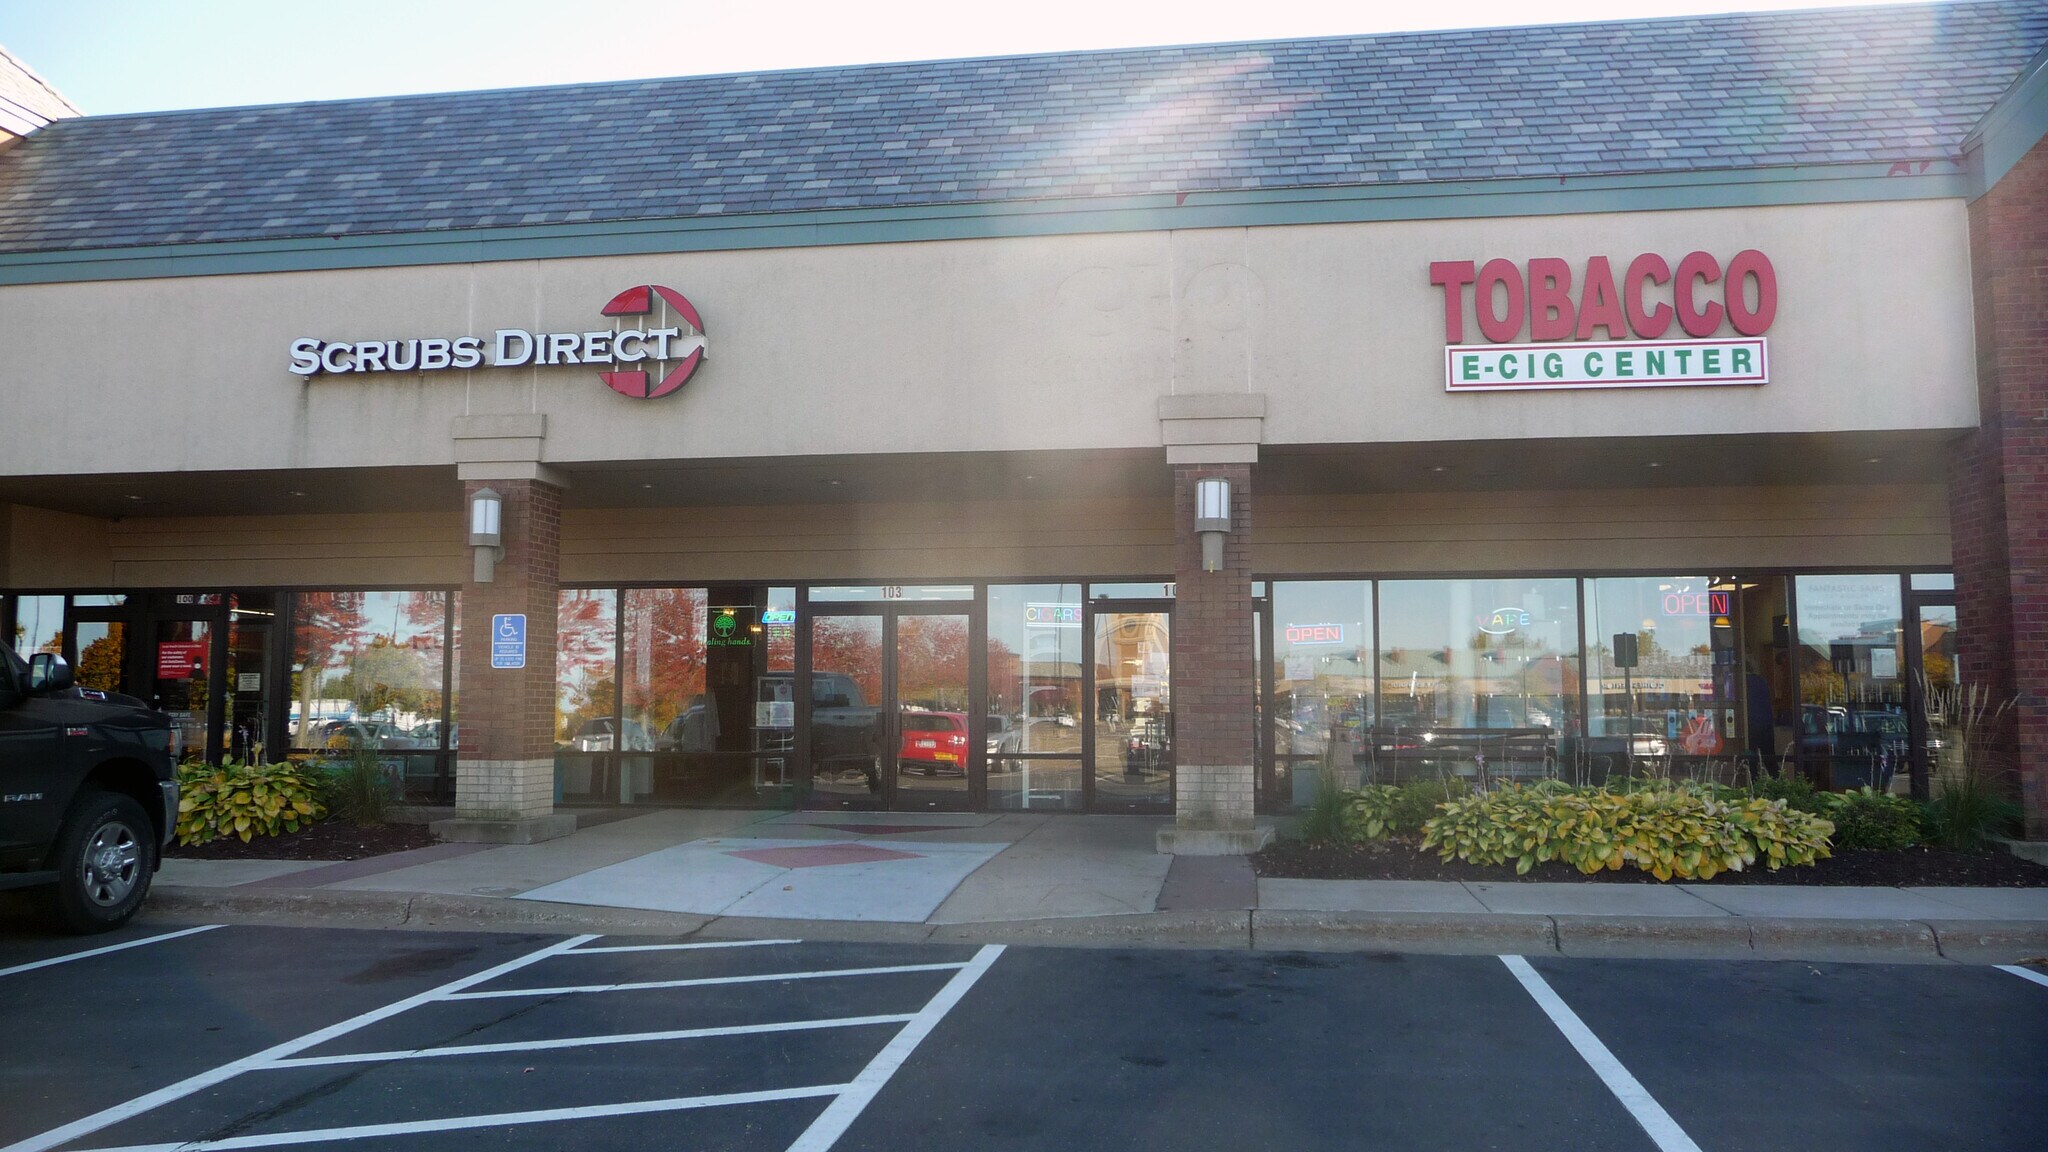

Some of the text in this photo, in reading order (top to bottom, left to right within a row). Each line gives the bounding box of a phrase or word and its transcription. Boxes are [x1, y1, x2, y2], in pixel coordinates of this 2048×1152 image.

[1429, 248, 1778, 344] TOBACCO
[288, 326, 681, 377] SCRUBS DIRECT
[1462, 348, 1753, 381] E-CIG CENTER
[881, 586, 902, 599] 103
[1664, 593, 1727, 615] OPEN
[765, 613, 794, 622] OPEN
[1026, 606, 1082, 621] CIGARS
[1475, 613, 1531, 626] VAPE
[1285, 626, 1340, 642] OPEN
[4, 793, 43, 803] RAM
